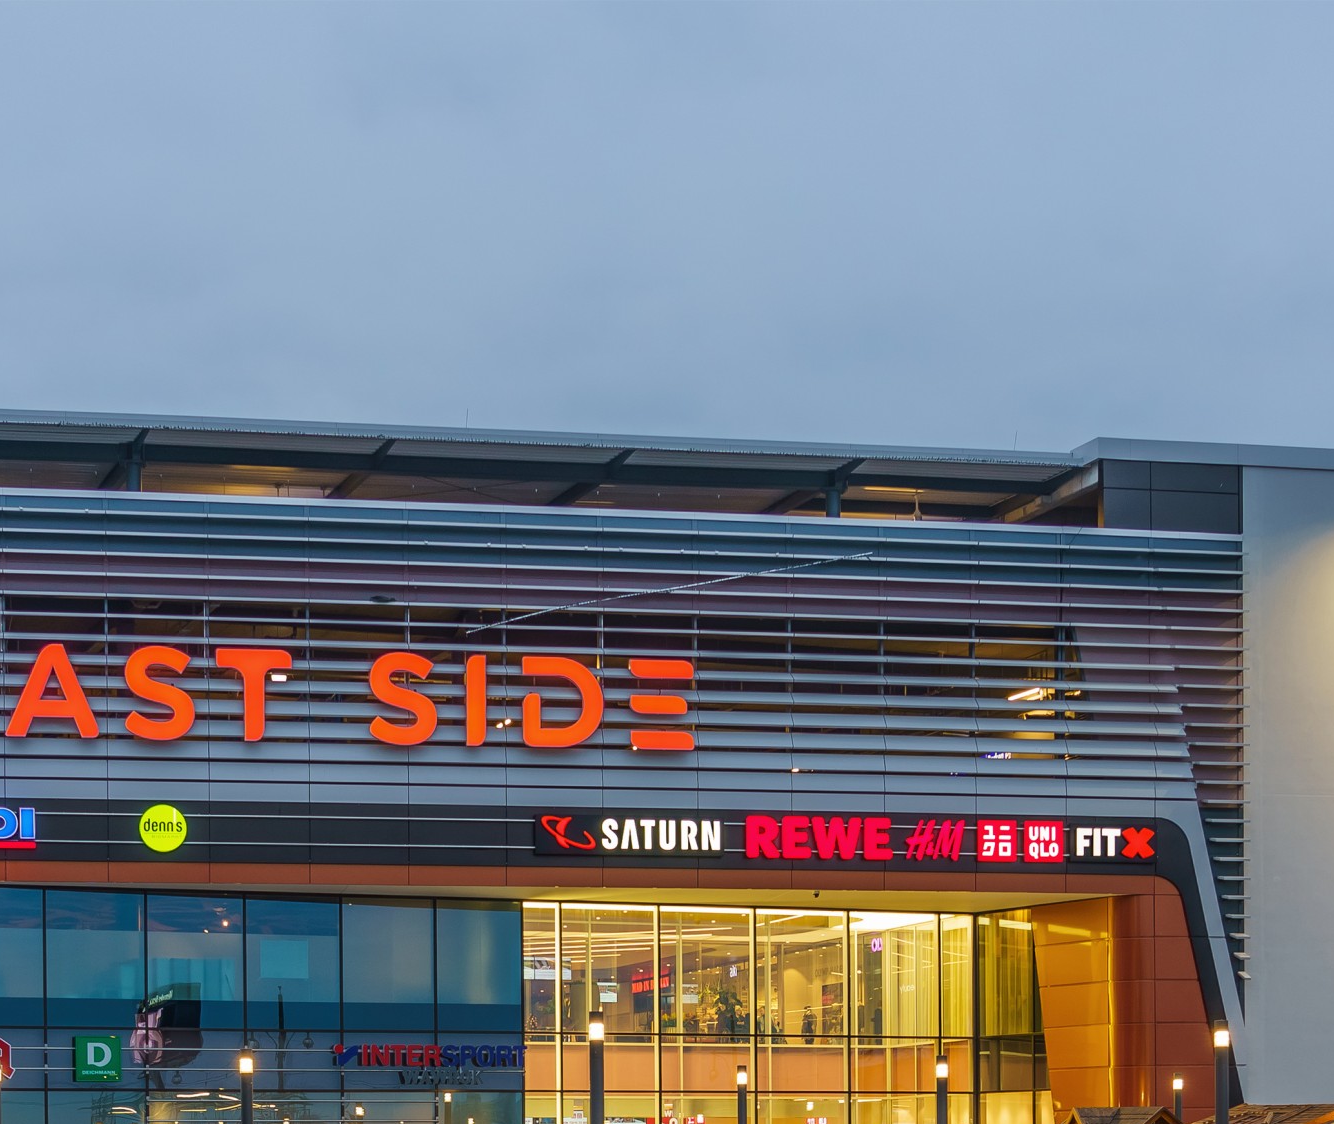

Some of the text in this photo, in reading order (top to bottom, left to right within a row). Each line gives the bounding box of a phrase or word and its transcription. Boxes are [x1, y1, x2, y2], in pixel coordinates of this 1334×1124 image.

[368, 651, 696, 752] SIDE
[601, 817, 721, 852] SATURN
[745, 815, 894, 861] REWE
[905, 818, 966, 862] H&M
[1028, 826, 1057, 841] UNI
[1028, 842, 1060, 858] QLO
[361, 1044, 528, 1068] INTERSPORT
